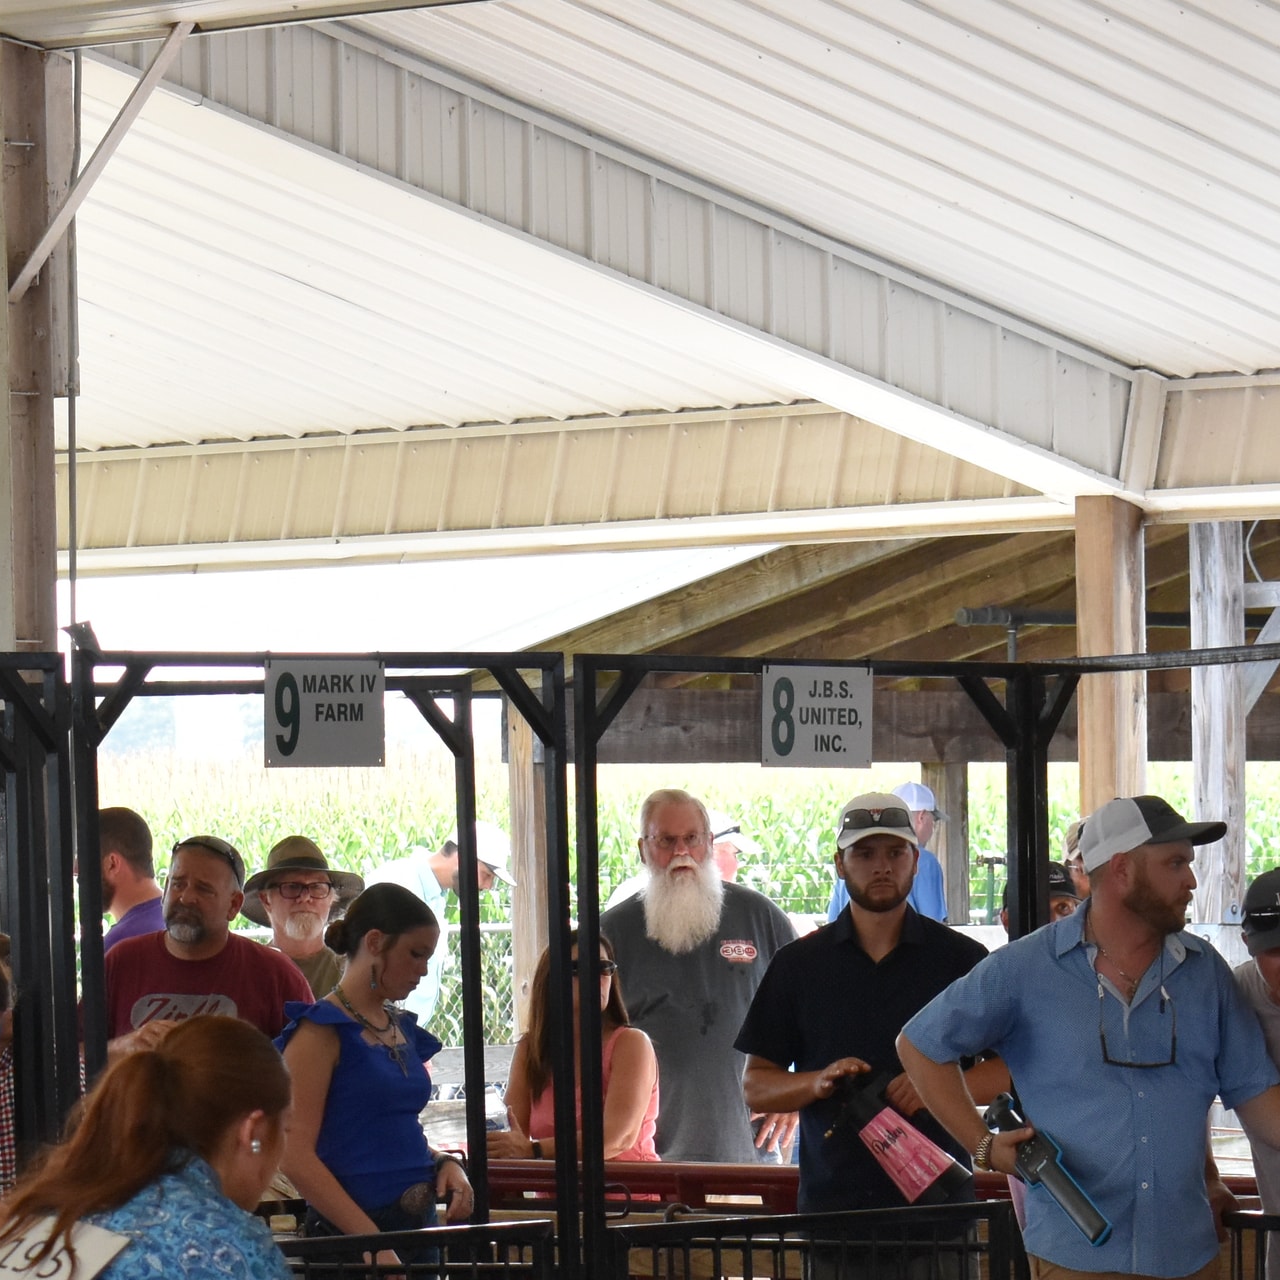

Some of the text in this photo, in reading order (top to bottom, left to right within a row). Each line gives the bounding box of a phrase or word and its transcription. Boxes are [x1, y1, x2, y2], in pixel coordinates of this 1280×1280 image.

[302, 674, 377, 693] MARK IV
[808, 681, 854, 698] J.B.S.
[274, 672, 300, 757] 9
[314, 703, 363, 721] FARM
[771, 676, 795, 757] 8
[799, 707, 862, 729] UNITED,
[814, 734, 847, 753] INC.
